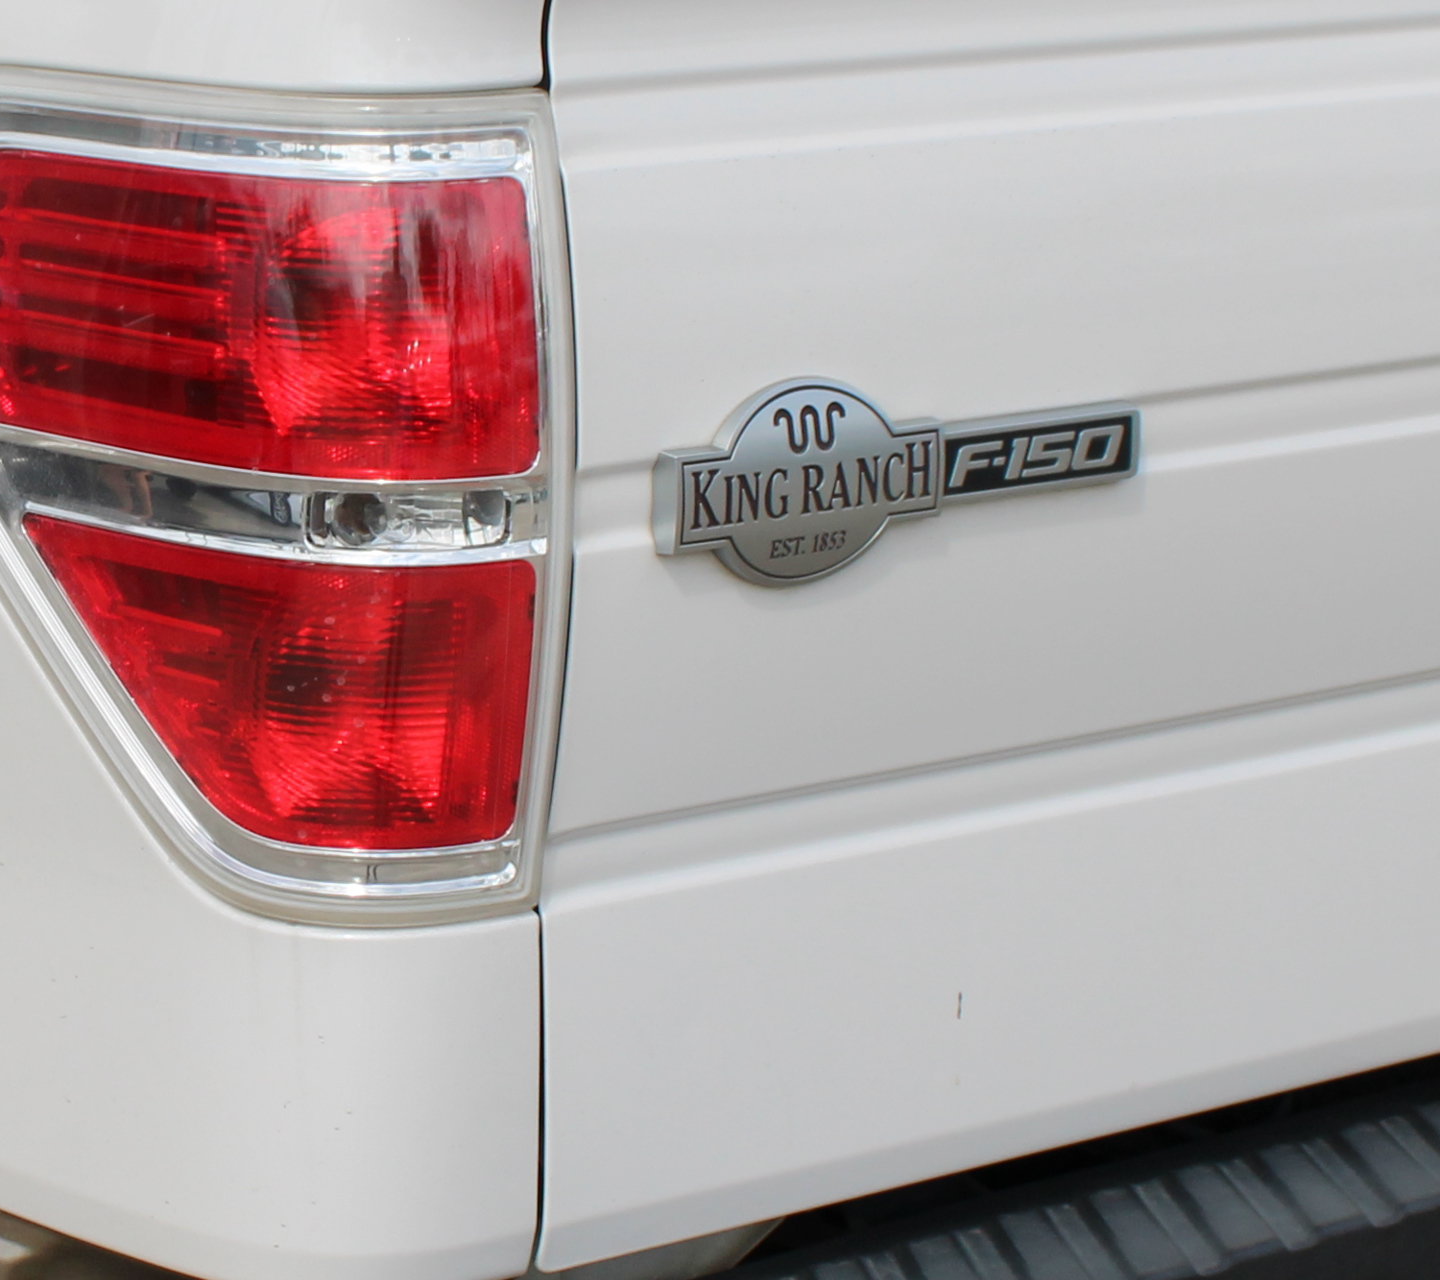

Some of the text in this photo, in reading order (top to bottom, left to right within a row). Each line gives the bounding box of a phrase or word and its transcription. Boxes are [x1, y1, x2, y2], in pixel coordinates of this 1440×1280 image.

[689, 441, 933, 532] KING RANCH
[948, 423, 1126, 489] F-150
[768, 529, 848, 561] EST. 1853
